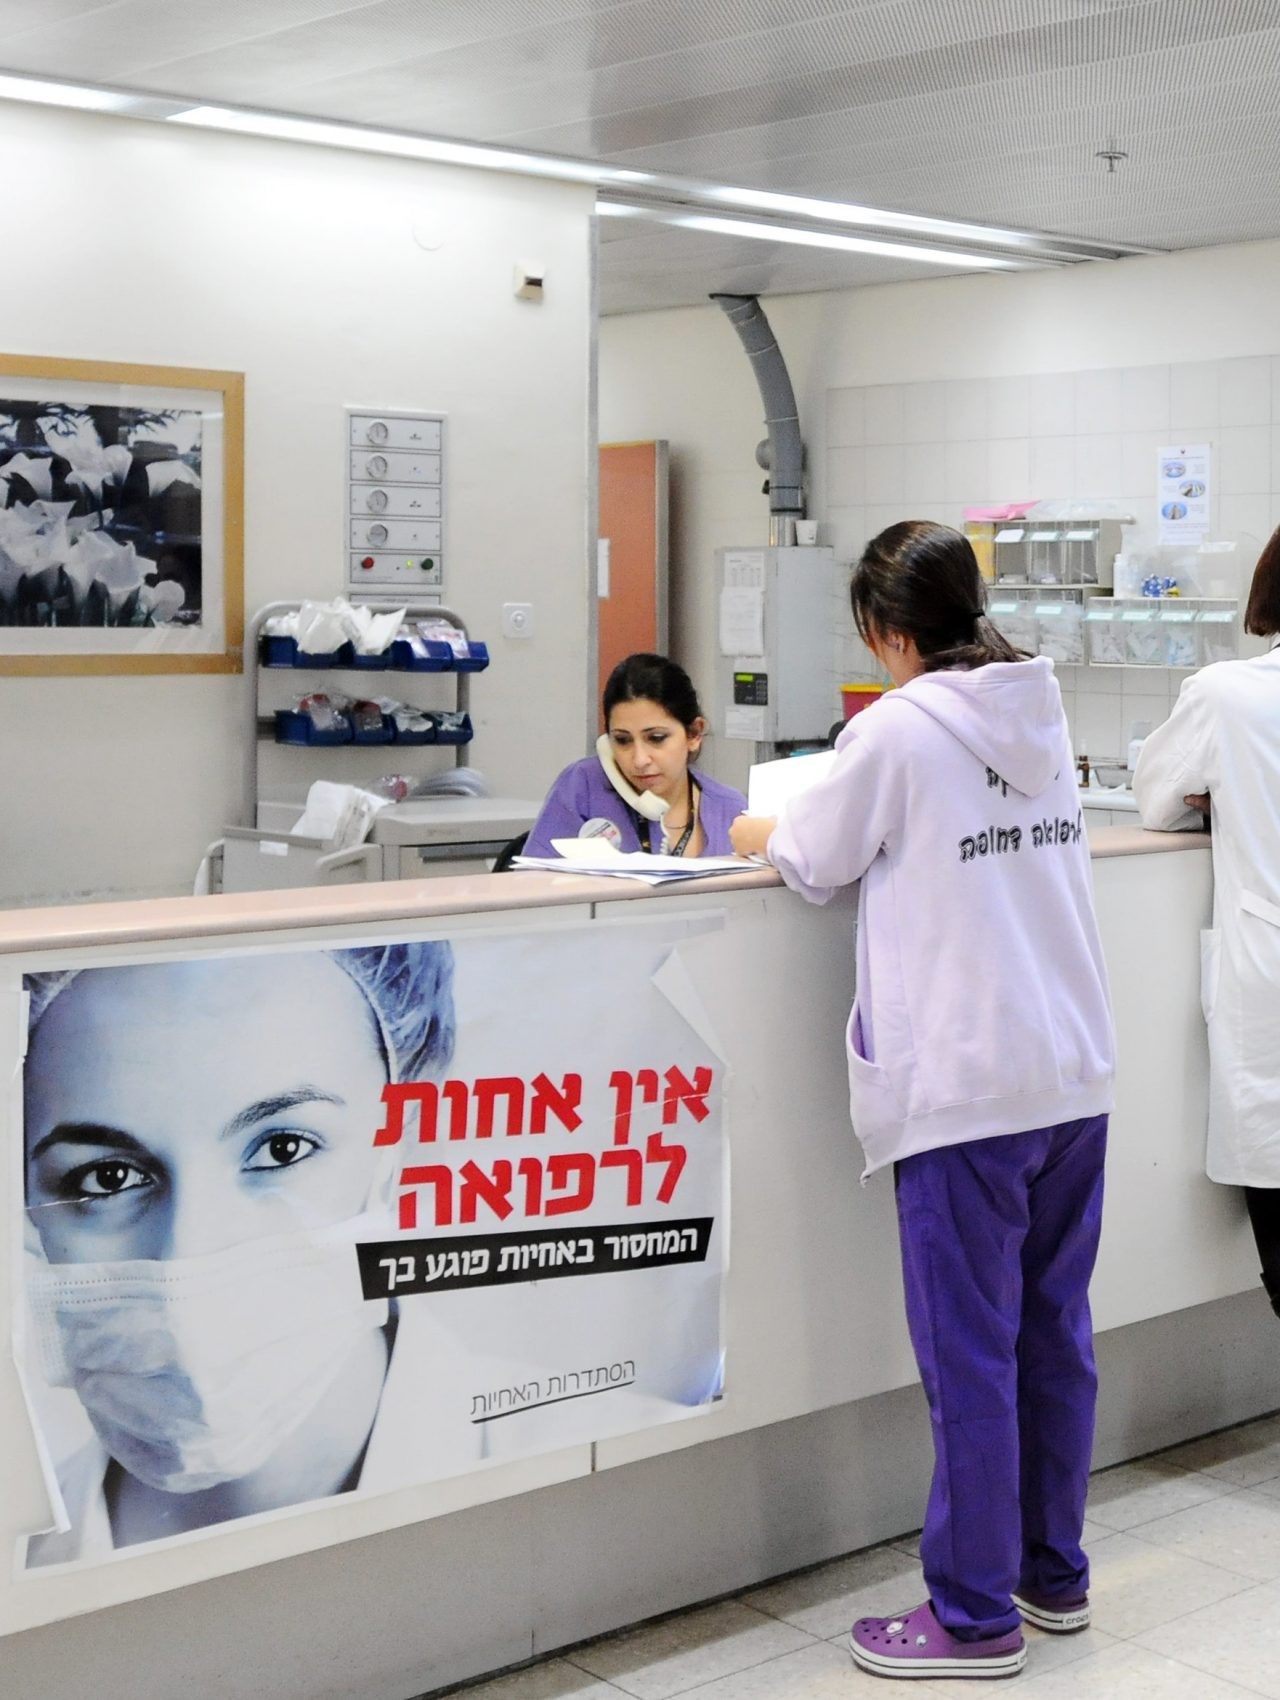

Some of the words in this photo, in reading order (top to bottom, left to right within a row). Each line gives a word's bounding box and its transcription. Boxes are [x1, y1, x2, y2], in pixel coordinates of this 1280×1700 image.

[959, 824, 1022, 863] דחופה
[371, 1071, 584, 1148] אחות
[608, 1064, 714, 1147] אין
[398, 1130, 688, 1231] לרפואה
[496, 1238, 596, 1274] באחיות
[603, 1227, 699, 1262] המחסור
[377, 1255, 417, 1291] בך
[424, 1248, 491, 1283] פוגע
[546, 1359, 636, 1397] הסתדרות
[469, 1381, 541, 1416] האחיות
